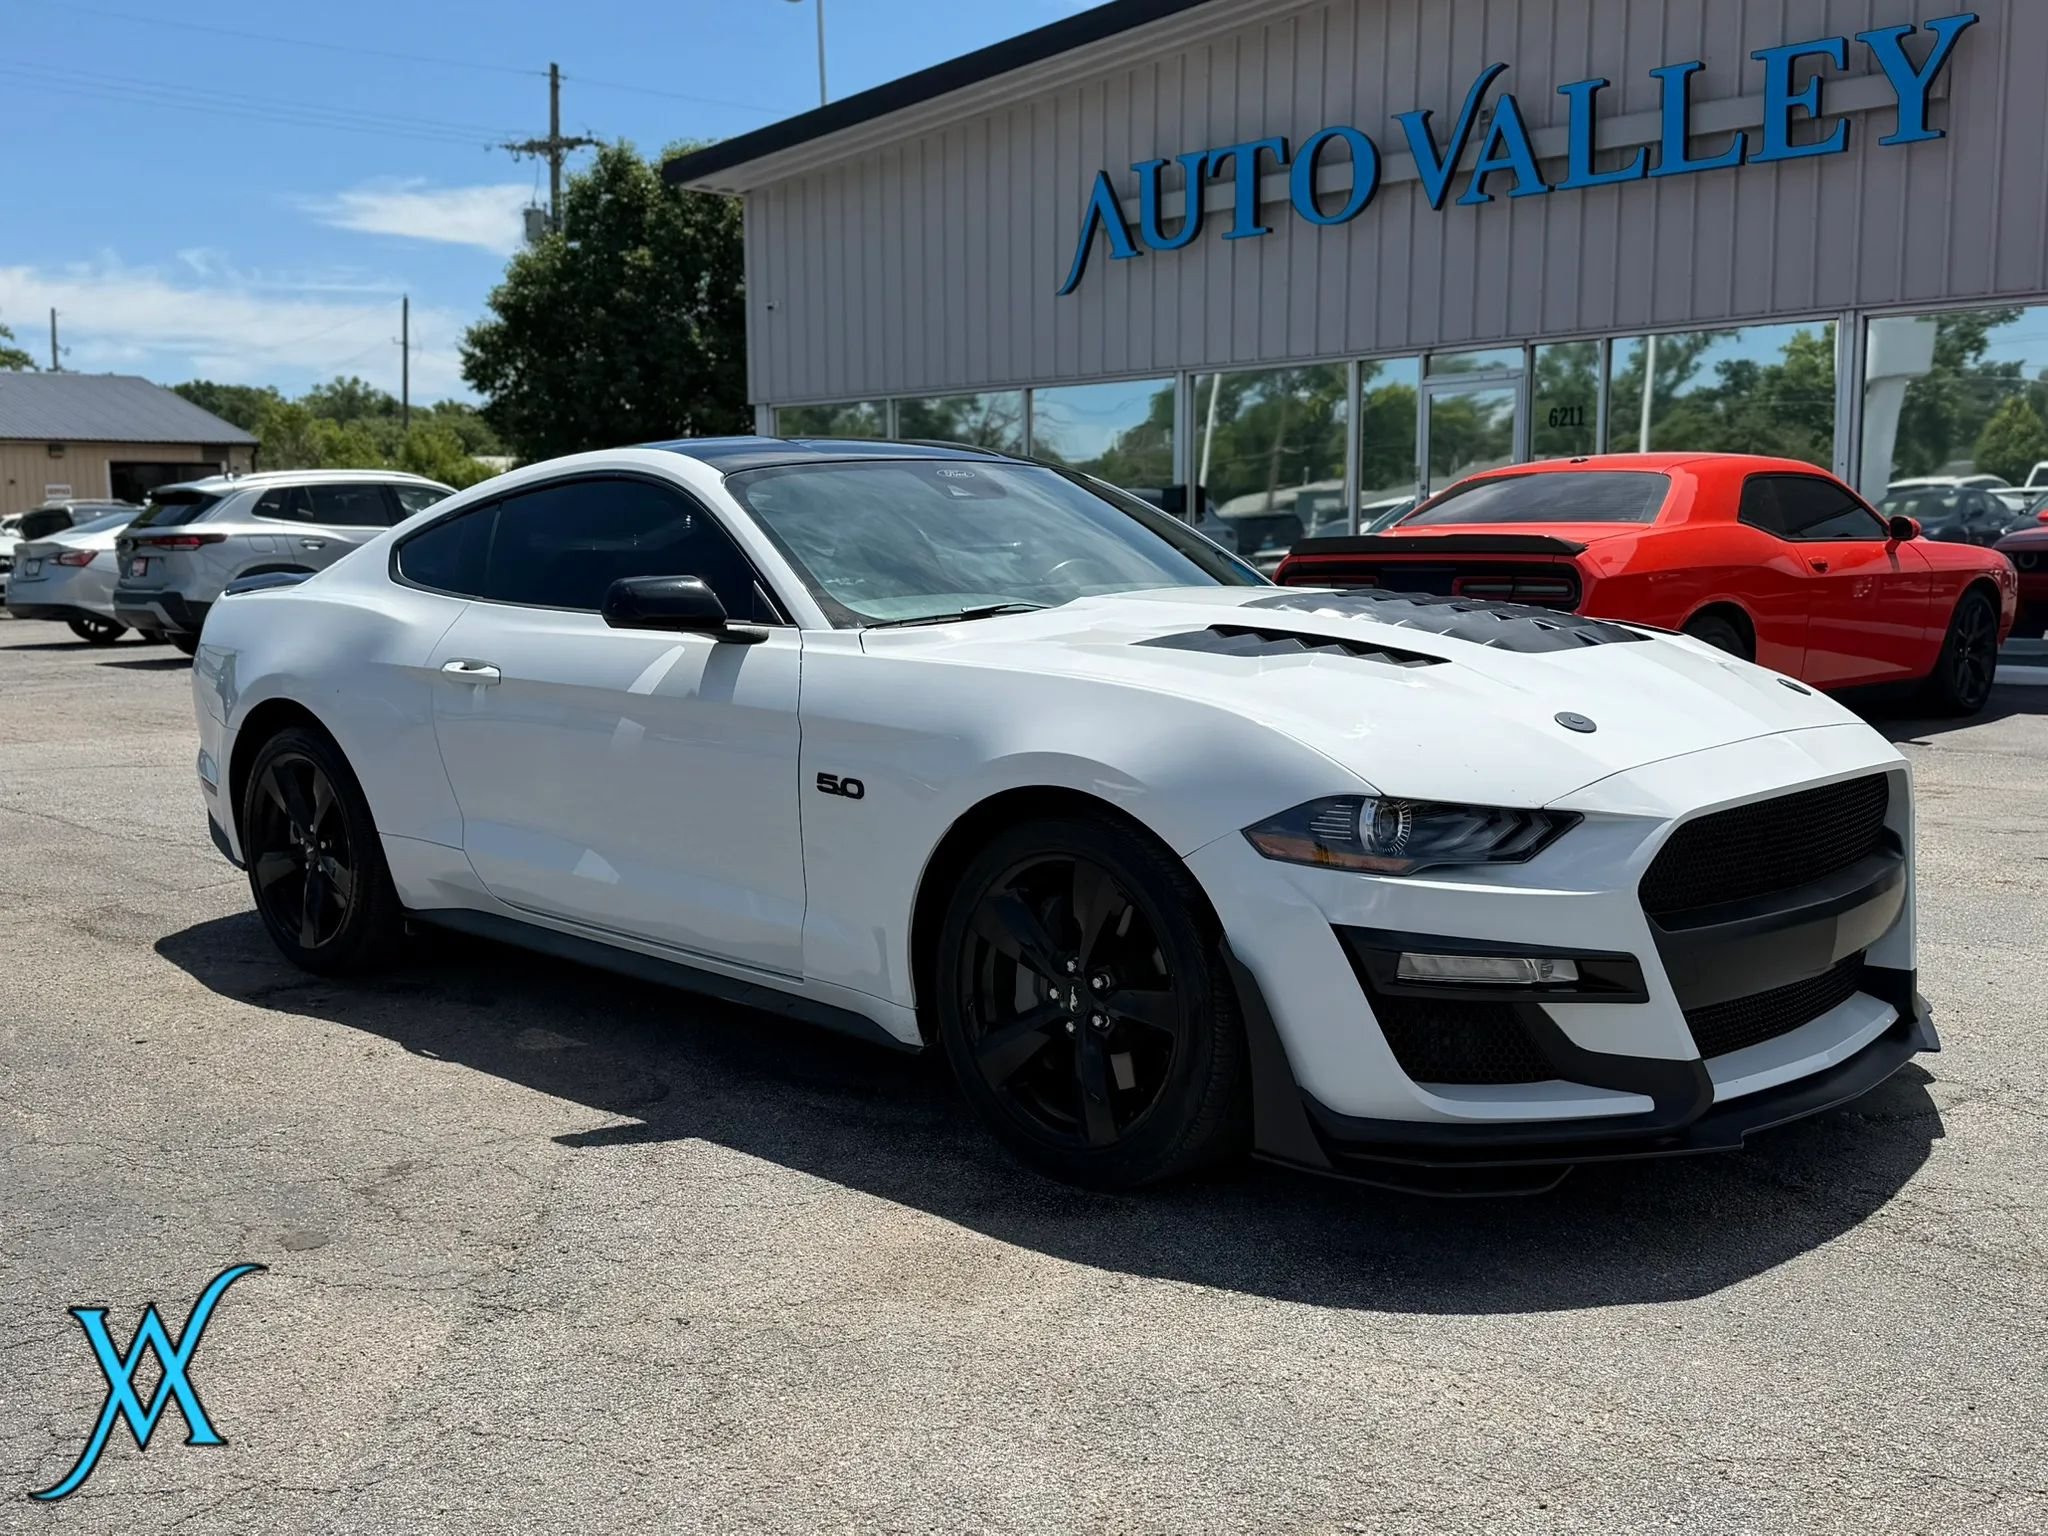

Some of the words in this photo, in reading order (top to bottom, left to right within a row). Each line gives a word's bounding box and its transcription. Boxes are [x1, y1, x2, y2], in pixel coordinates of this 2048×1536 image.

[1056, 126, 1381, 296] AUTO
[1392, 12, 1979, 211] VALLEY
[1549, 406, 1584, 428] 6211
[816, 771, 865, 800] 5.0
